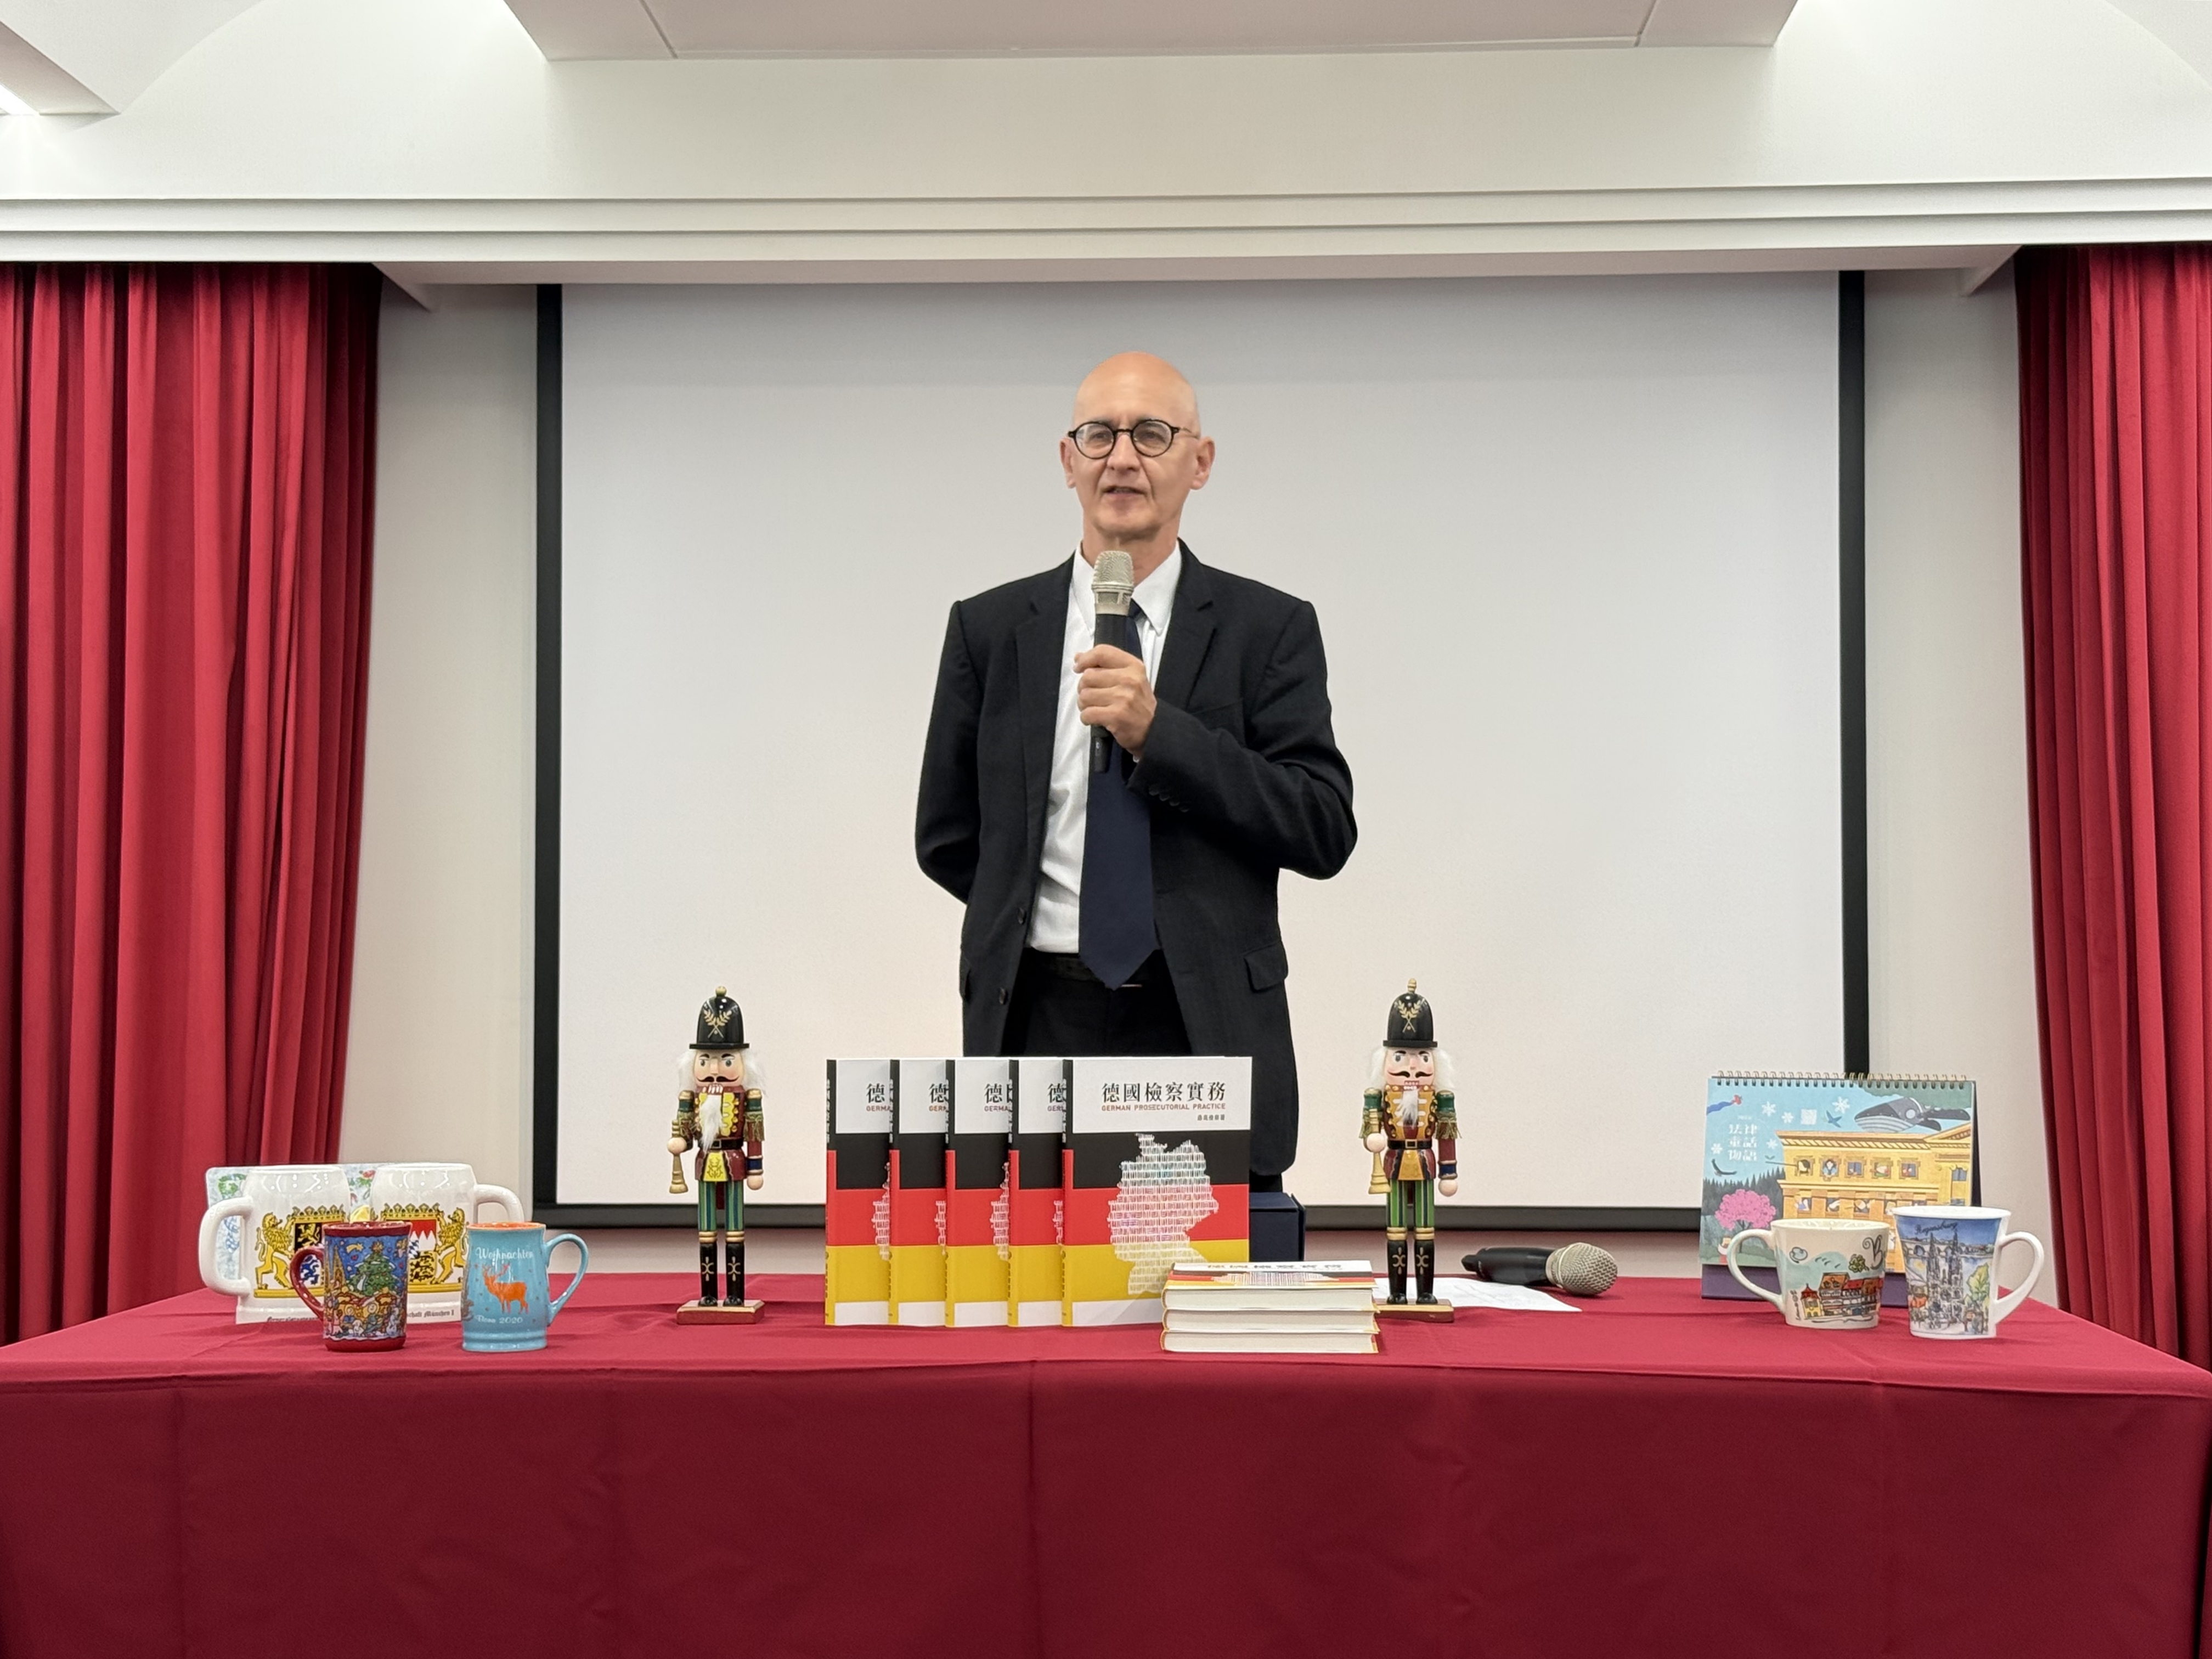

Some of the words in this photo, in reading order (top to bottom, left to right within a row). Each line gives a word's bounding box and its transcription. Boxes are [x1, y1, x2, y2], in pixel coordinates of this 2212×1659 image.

[984, 1083, 1009, 1103] 德
[1102, 1081, 1226, 1103] 德國檢察實務
